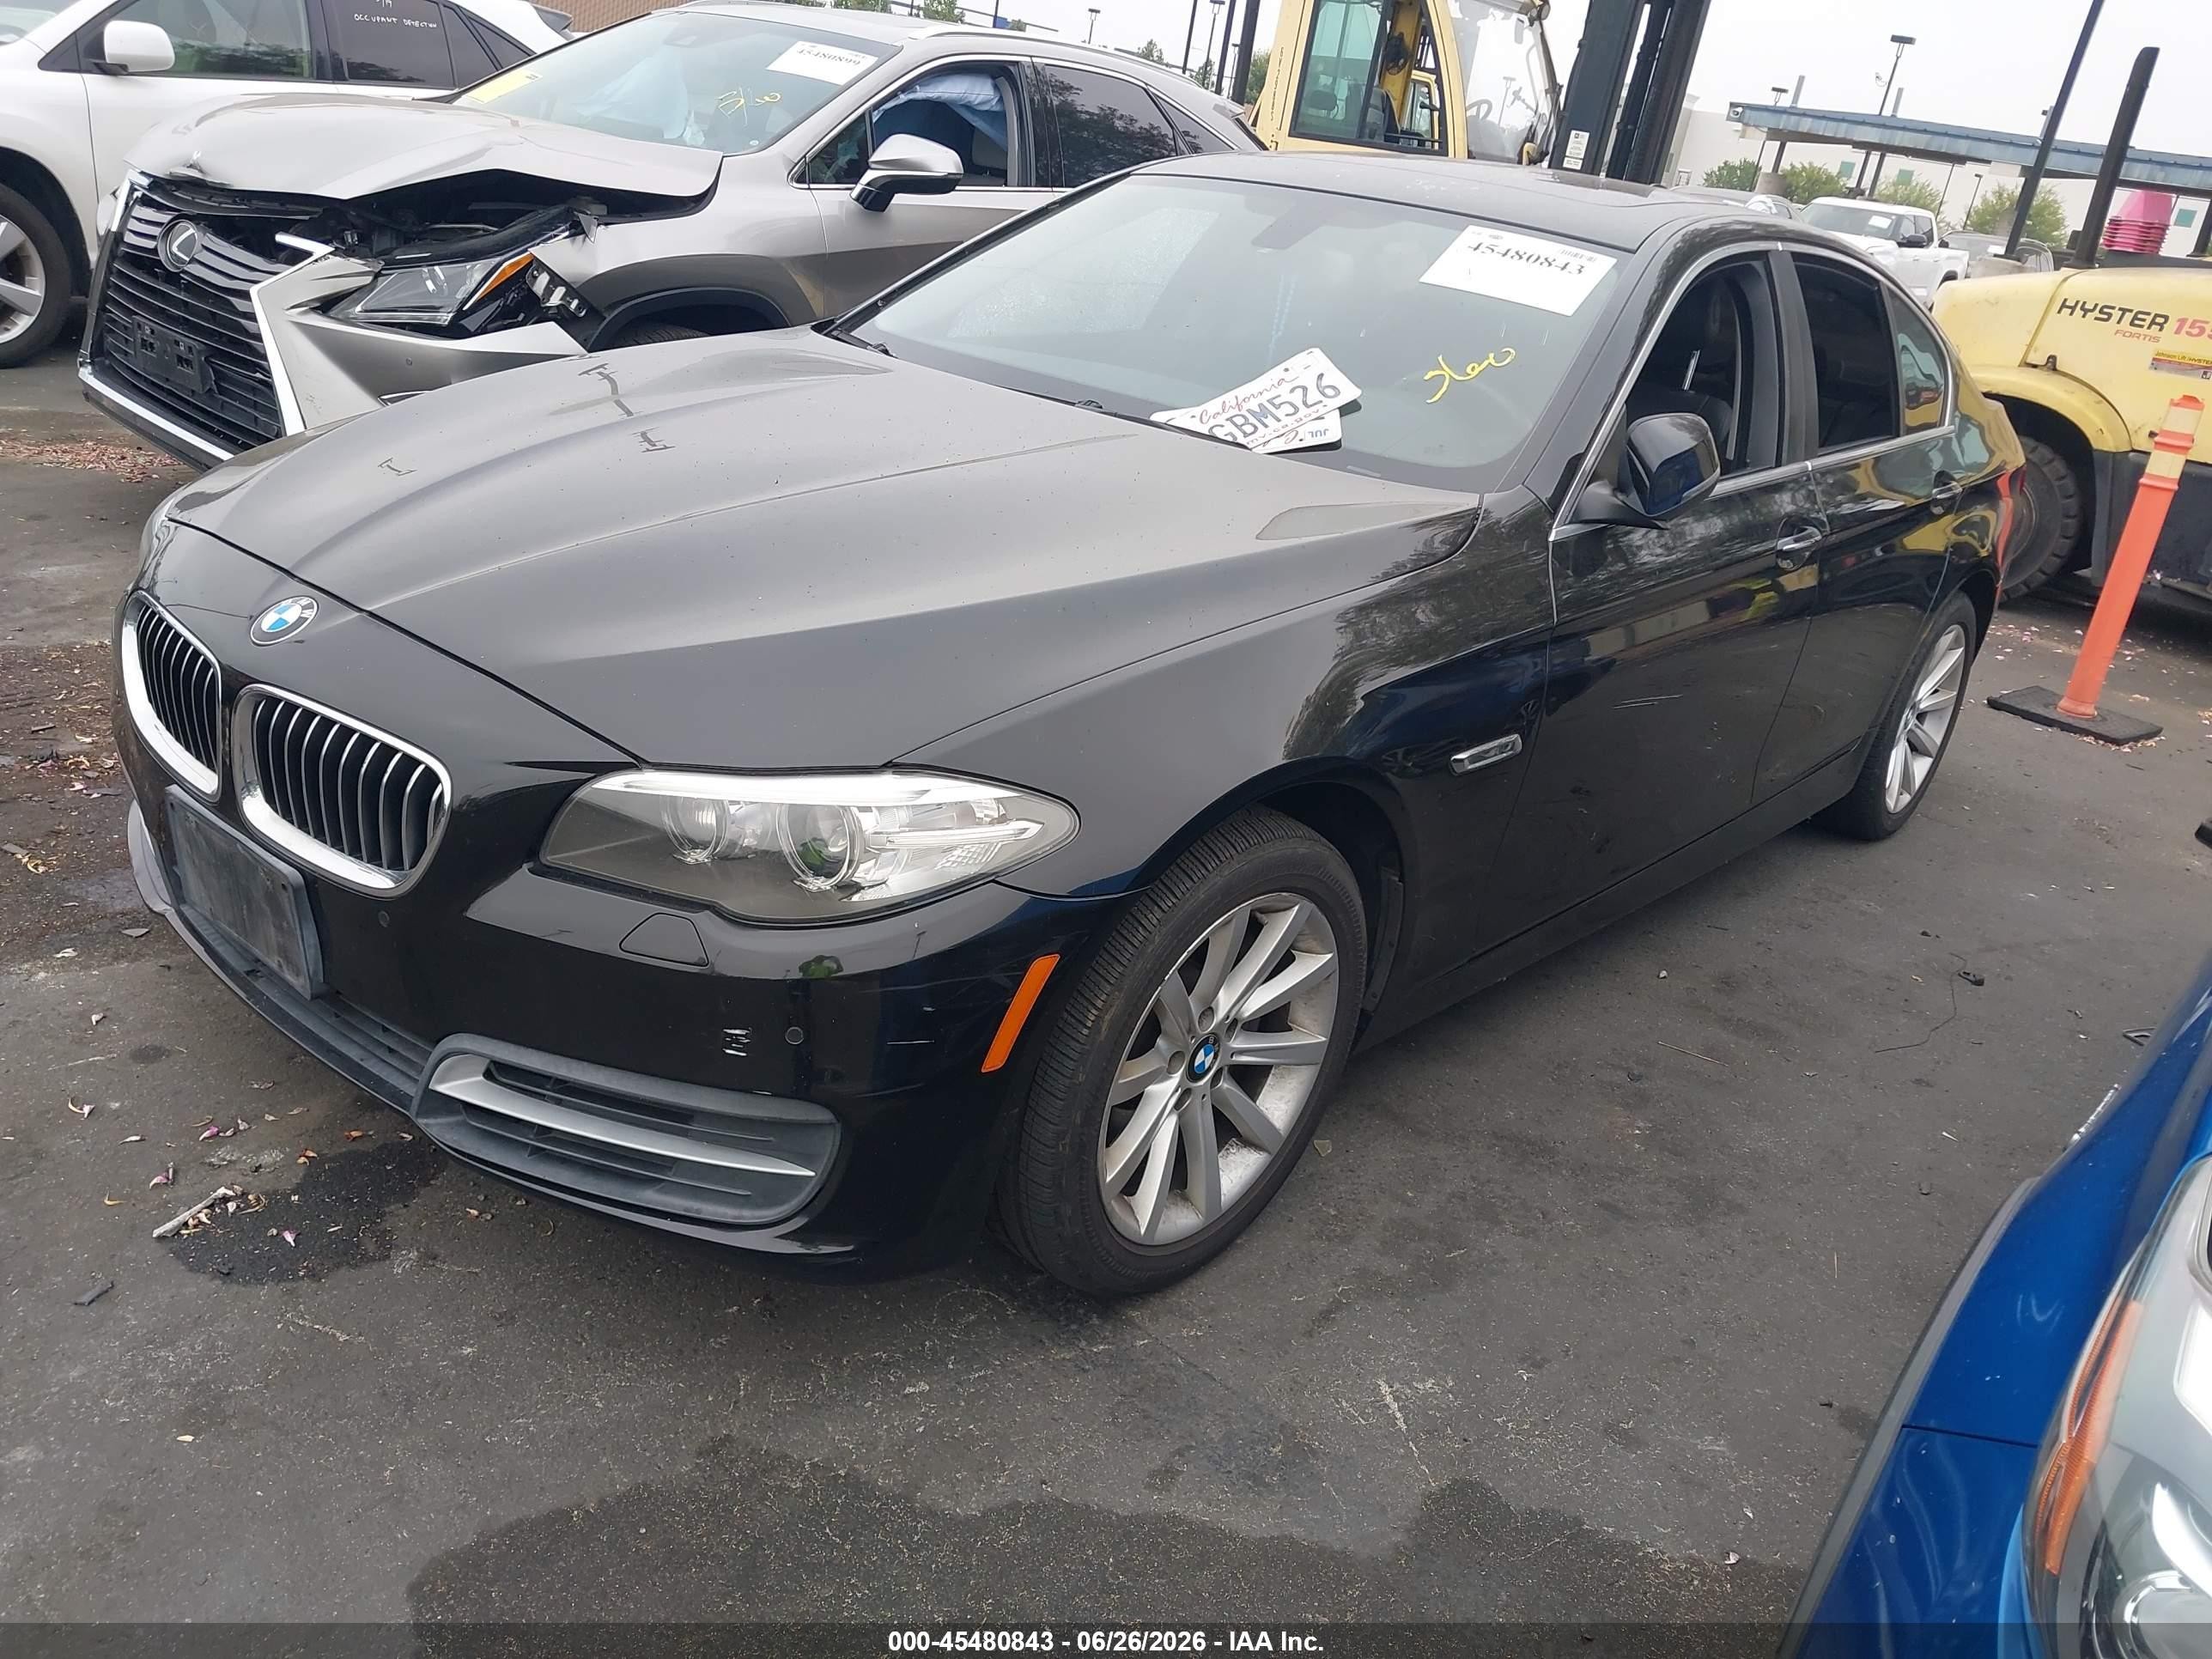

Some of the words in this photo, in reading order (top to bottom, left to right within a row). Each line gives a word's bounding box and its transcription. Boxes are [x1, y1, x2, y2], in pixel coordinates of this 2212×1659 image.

[1468, 241, 1586, 276] 45480843
[2057, 297, 2170, 332] HYSTER
[2172, 316, 2212, 341] 15
[2114, 329, 2162, 343] FORTIS
[1199, 375, 1299, 425] California
[1207, 372, 1341, 443] GBM526
[1308, 428, 1329, 439] JUL
